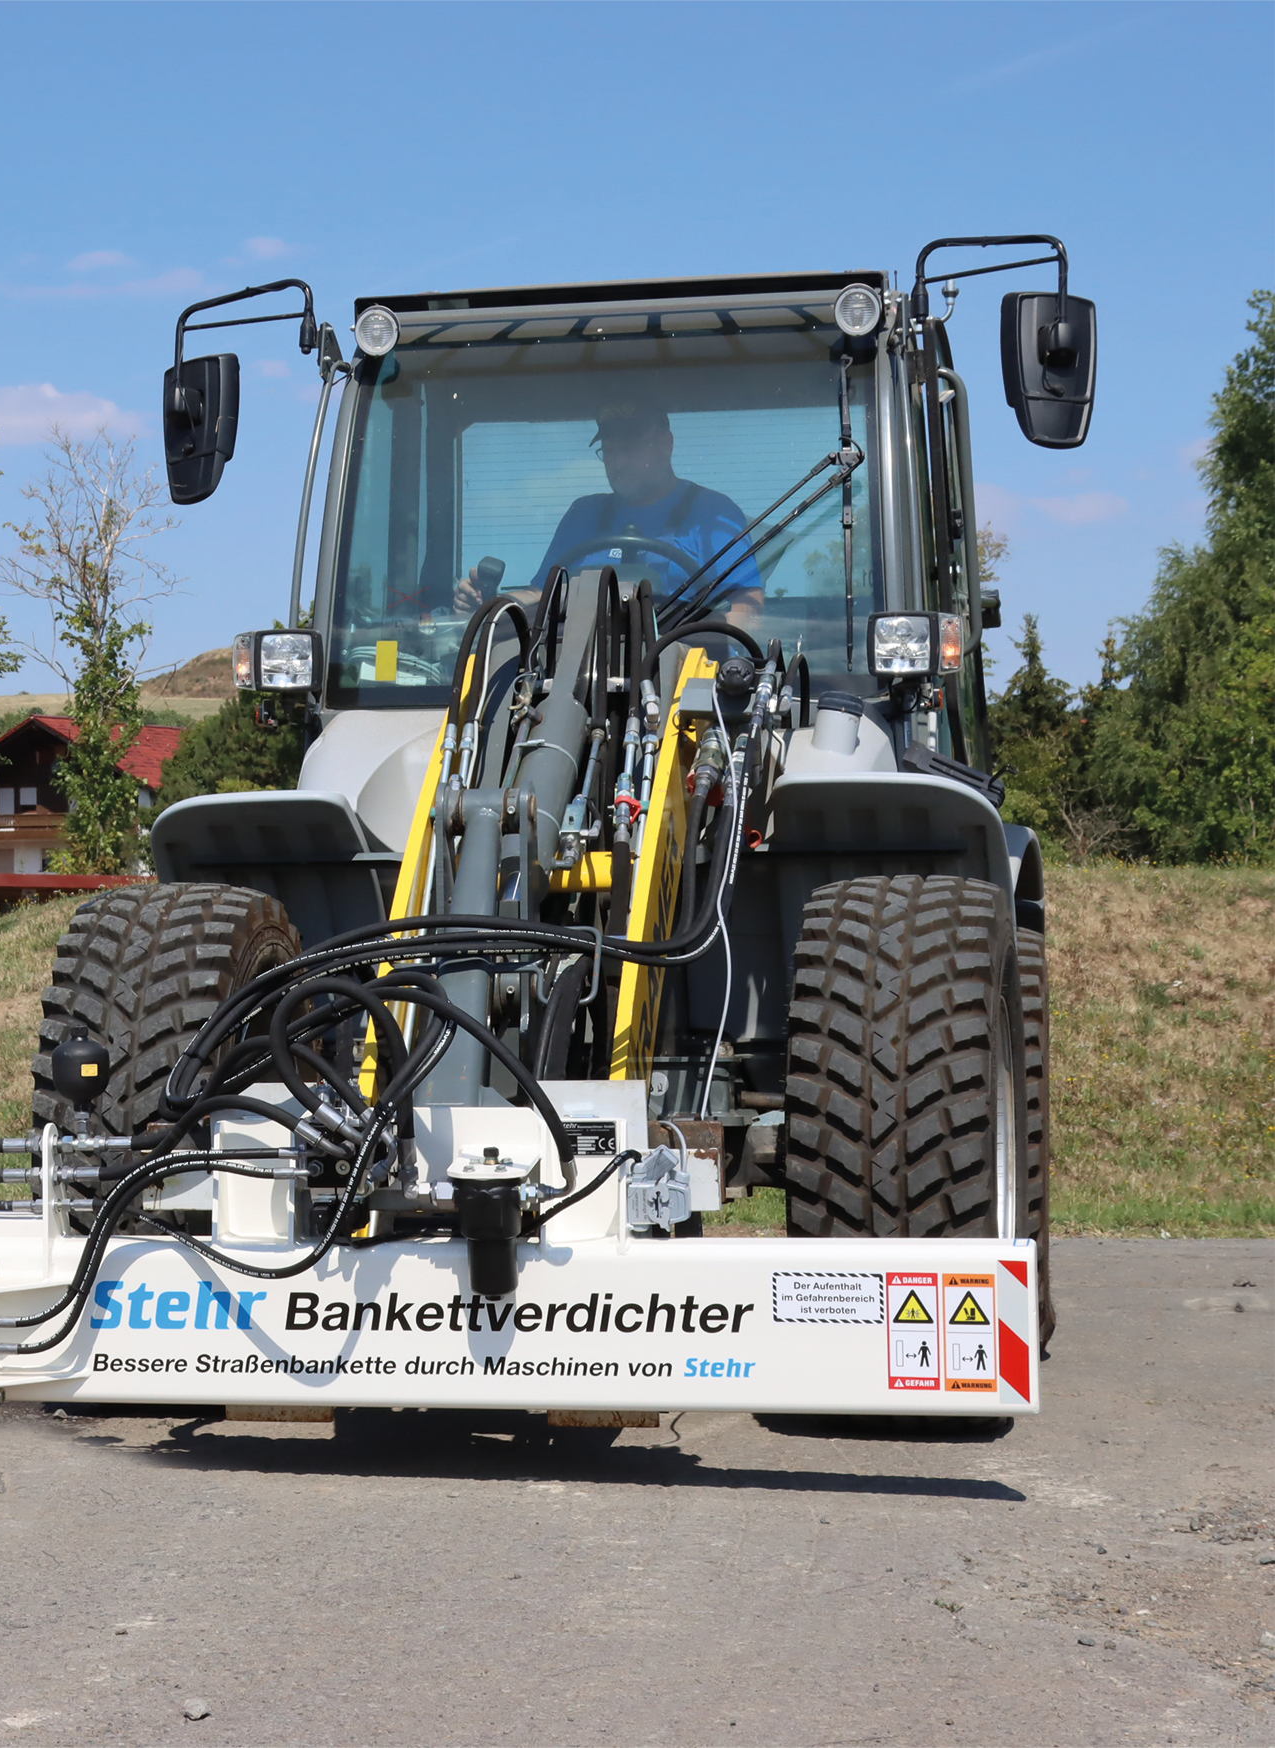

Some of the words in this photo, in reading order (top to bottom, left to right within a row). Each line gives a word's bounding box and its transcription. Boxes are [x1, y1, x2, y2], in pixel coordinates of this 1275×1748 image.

[902, 1276, 933, 1285] DANGER
[793, 1281, 810, 1290] Der
[813, 1282, 862, 1291] Aufenthalt
[781, 1294, 793, 1302] im
[795, 1293, 875, 1303] Gefahrenbereich
[90, 1280, 267, 1330] Stehr
[285, 1291, 754, 1333] Bankettverdichter
[800, 1305, 812, 1314] ist
[814, 1306, 857, 1315] verboten
[93, 1353, 188, 1373] Bessere
[195, 1354, 396, 1374] Straßenbankette
[404, 1356, 475, 1375] durch
[483, 1356, 619, 1376] Maschinen
[628, 1362, 672, 1377] von
[684, 1357, 757, 1378] Stehr
[904, 1379, 935, 1388] GEFAHR
